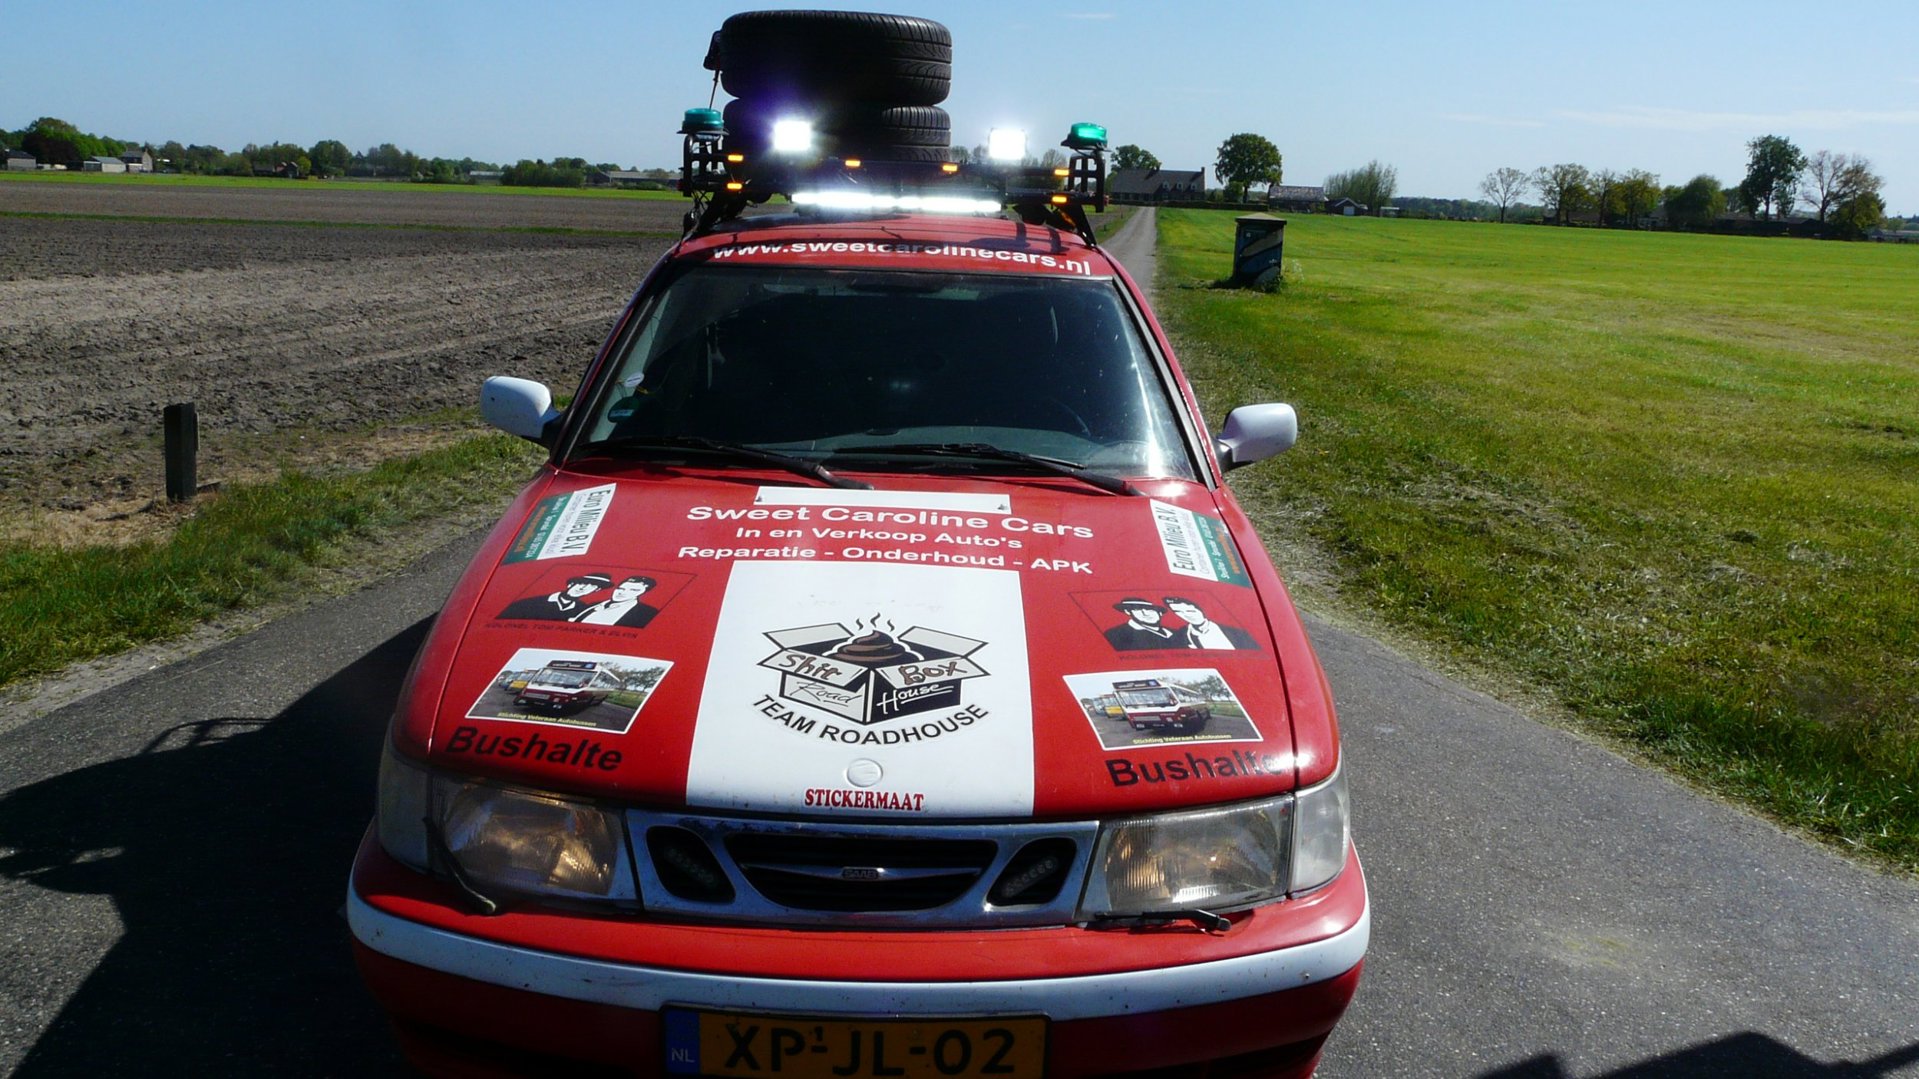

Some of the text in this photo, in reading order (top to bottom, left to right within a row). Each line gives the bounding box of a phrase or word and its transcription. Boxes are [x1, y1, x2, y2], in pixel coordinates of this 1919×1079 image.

[713, 241, 1091, 275] www.sweetcarolinecars.nl
[687, 506, 1094, 538] Sweet Caroline Cars
[736, 527, 1023, 549] In en Verkoop Auto's
[678, 546, 816, 560] Reparatie
[842, 547, 1005, 567] Onderhoud
[1030, 558, 1093, 575] APK
[788, 681, 863, 707] Road
[876, 683, 955, 715] House
[753, 694, 990, 746] TEAM ROADHOUSE
[446, 725, 623, 771] Bushalte
[804, 788, 924, 811] STICKERMAAT
[670, 1048, 695, 1064] NL
[724, 1024, 1016, 1076] XP-JL-02
